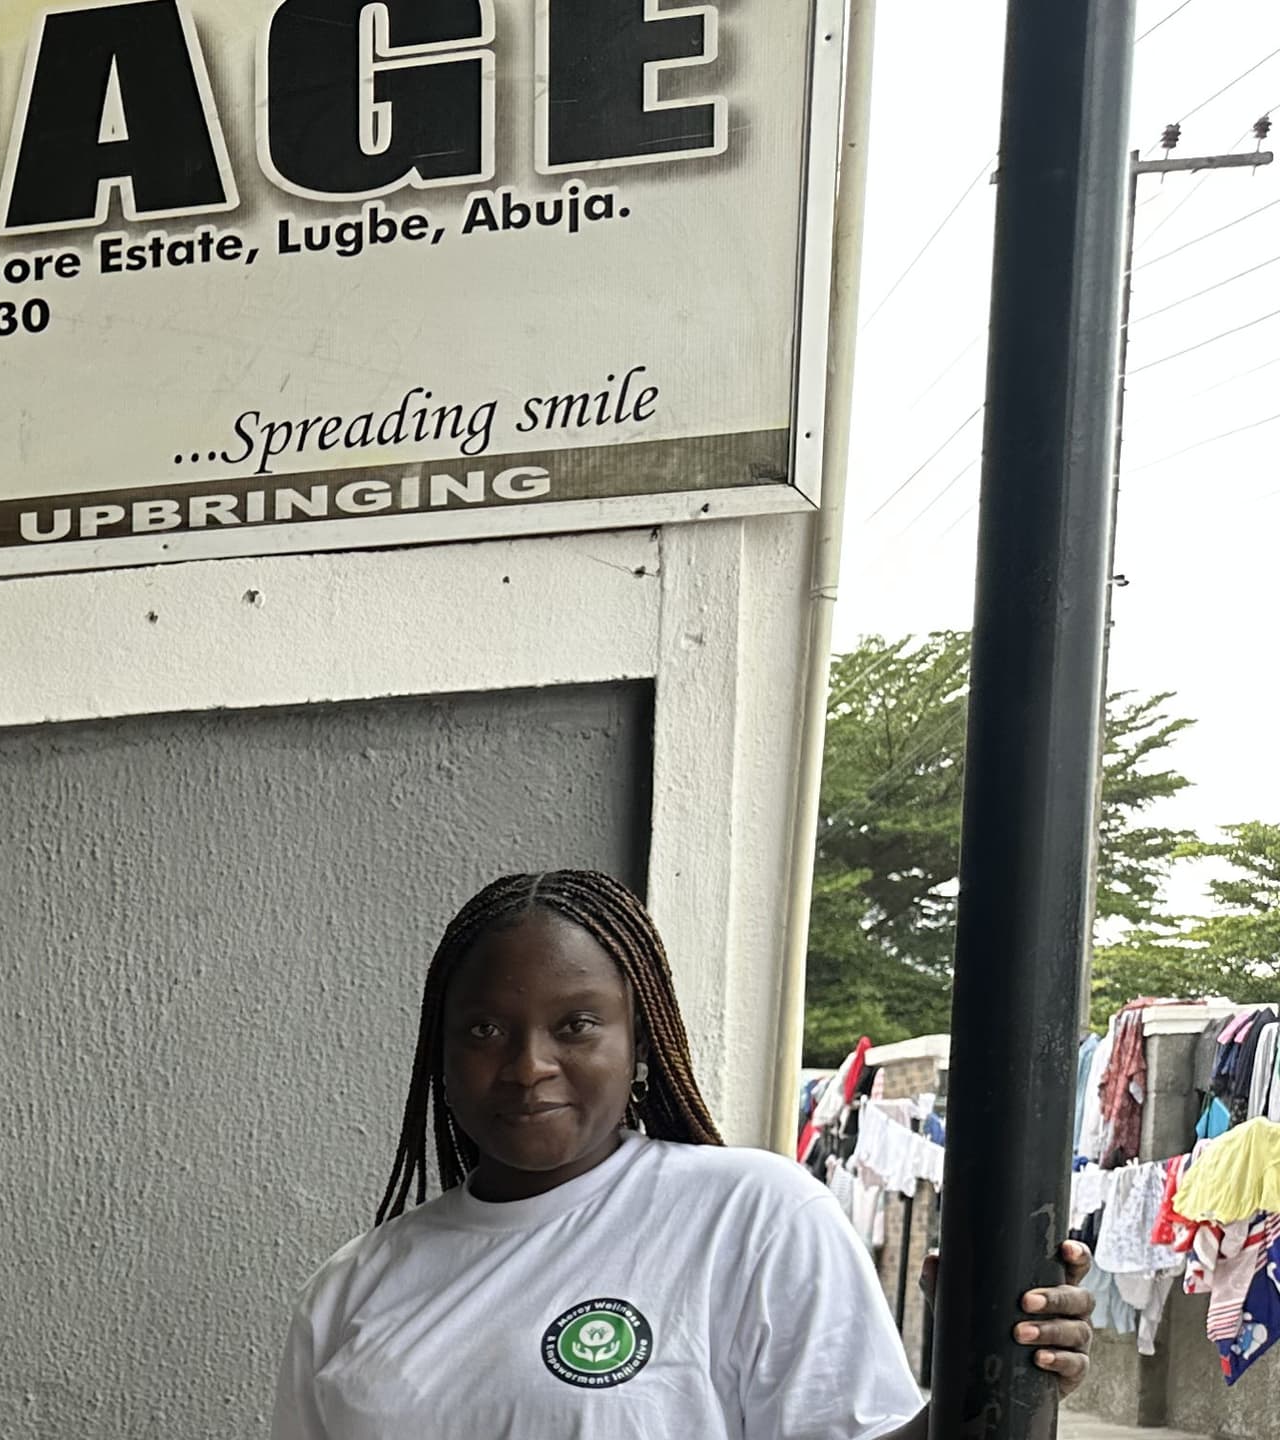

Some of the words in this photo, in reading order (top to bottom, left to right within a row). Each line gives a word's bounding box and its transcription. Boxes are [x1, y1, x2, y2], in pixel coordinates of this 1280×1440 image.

[100, 231, 259, 274] Estate,
[278, 208, 446, 257] Lugbe,
[462, 186, 632, 234] Abuja.
[173, 386, 498, 474] ...Spreading
[516, 365, 660, 433] smile
[19, 466, 551, 542] UPBRINGING
[595, 1302, 641, 1327] Wellness
[546, 1344, 610, 1384] Empowerment
[612, 1339, 648, 1381] Initiative
